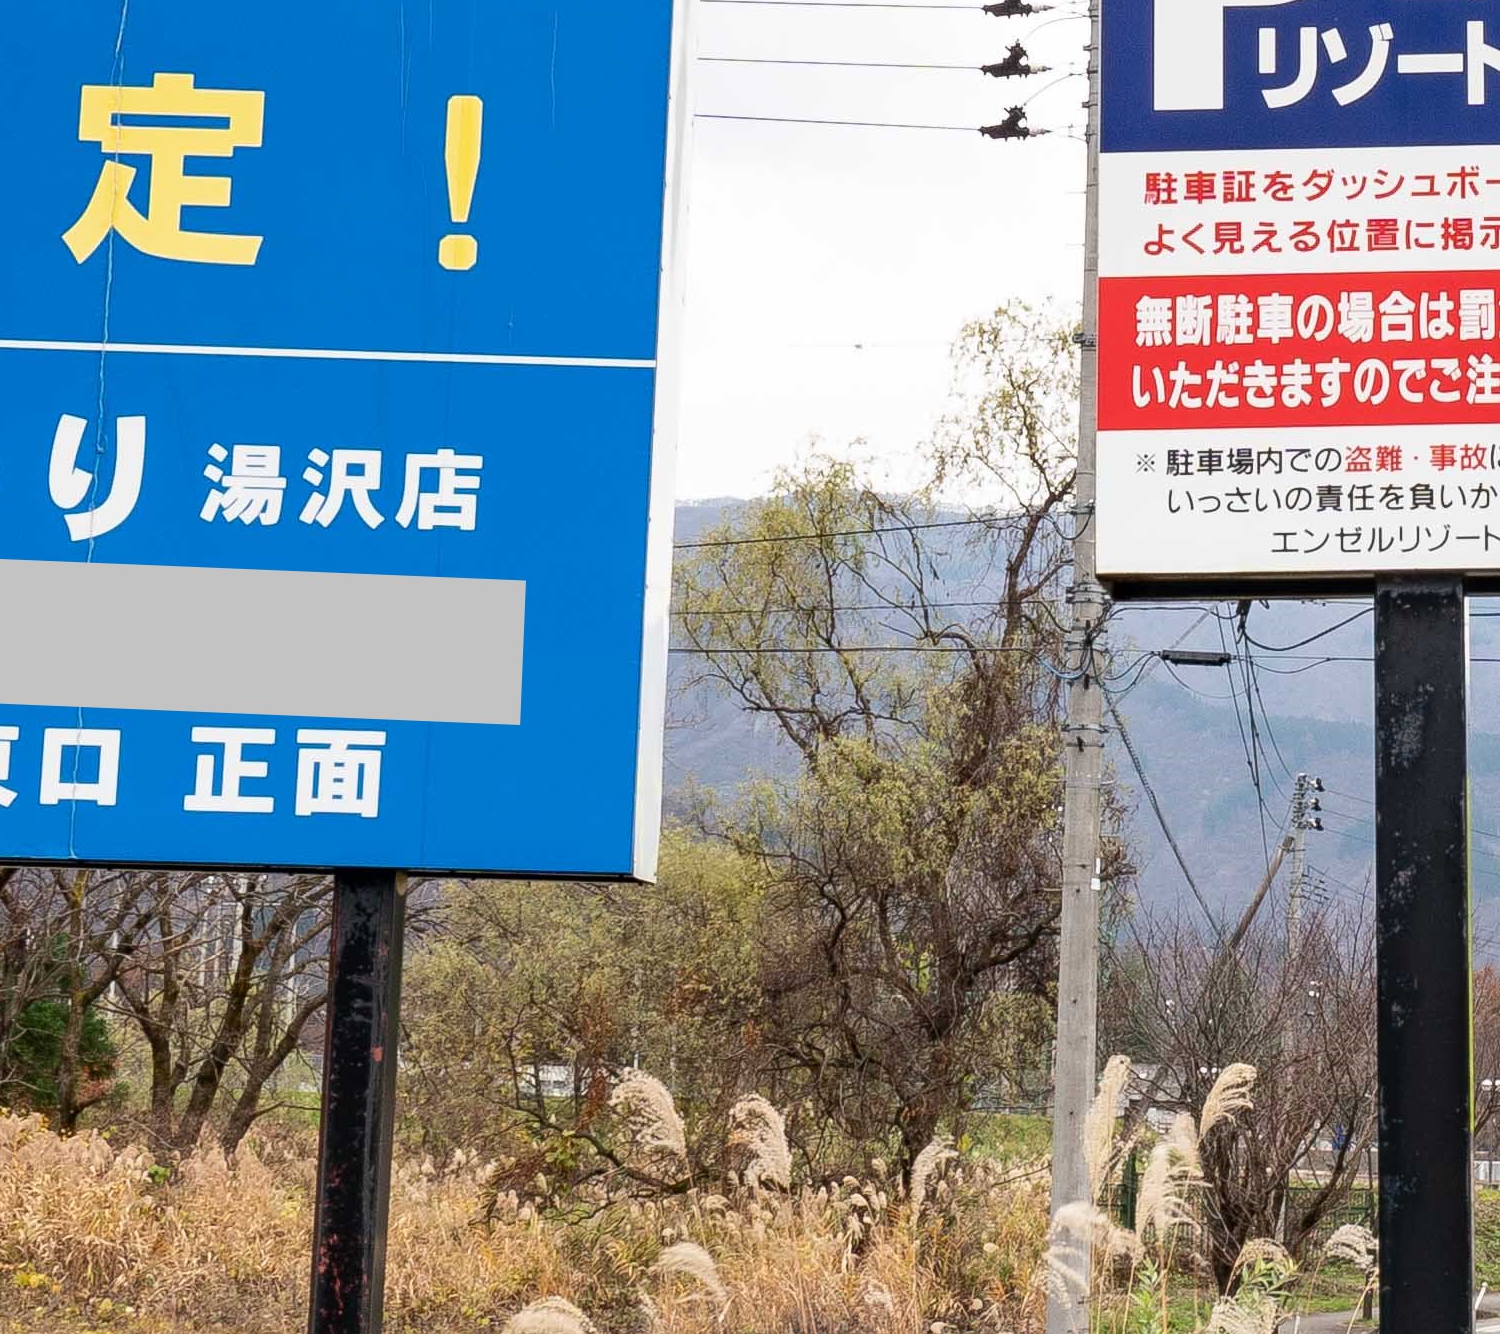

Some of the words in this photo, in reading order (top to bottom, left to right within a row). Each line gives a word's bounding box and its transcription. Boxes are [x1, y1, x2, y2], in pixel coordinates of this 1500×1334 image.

[200, 443, 483, 531] 湯沢店
[183, 726, 386, 818] 正面
